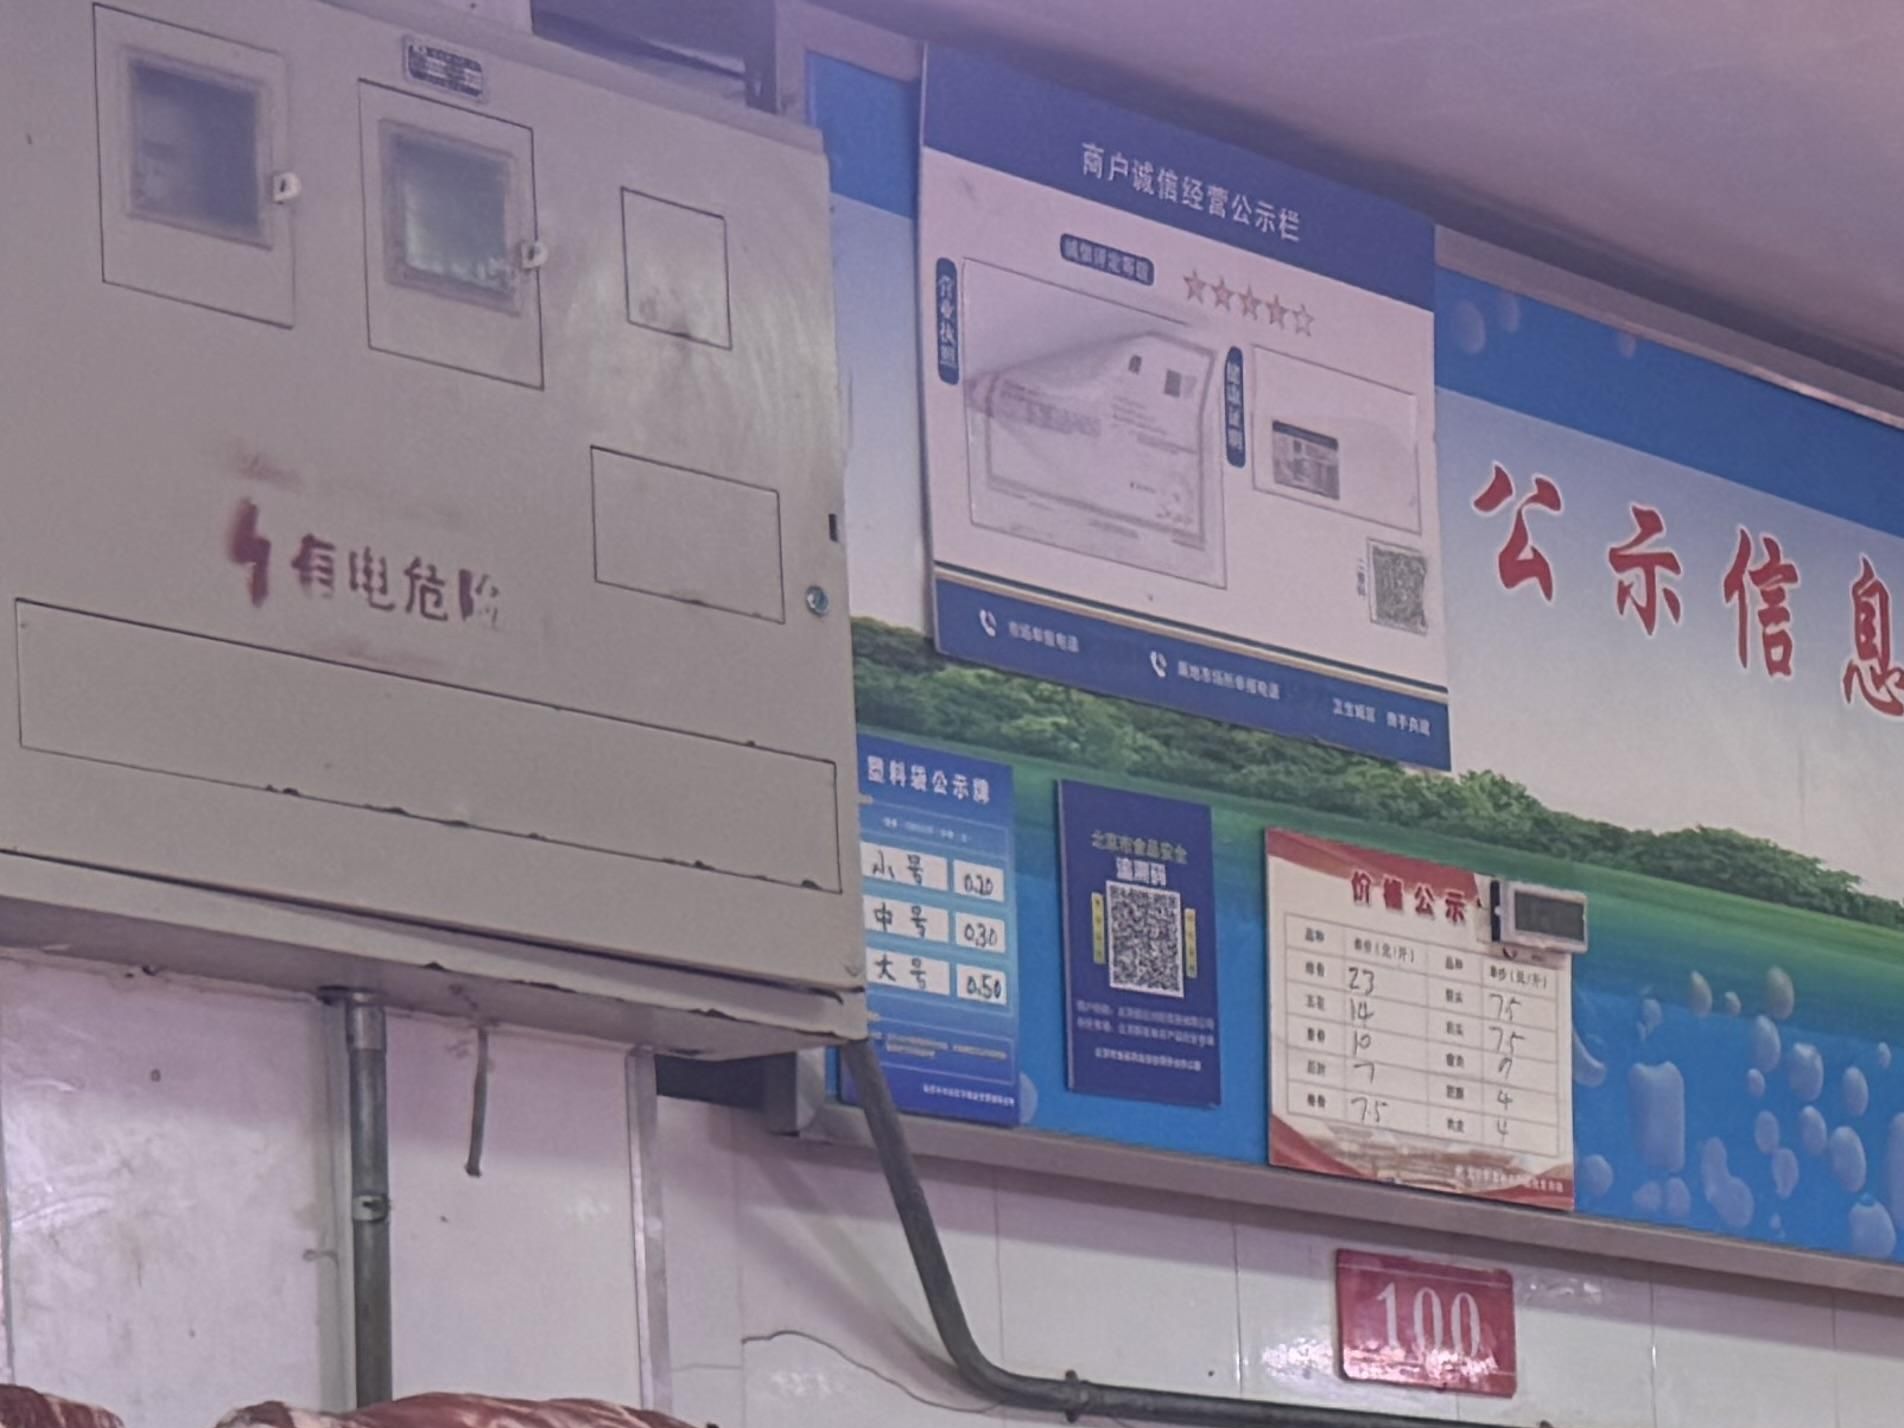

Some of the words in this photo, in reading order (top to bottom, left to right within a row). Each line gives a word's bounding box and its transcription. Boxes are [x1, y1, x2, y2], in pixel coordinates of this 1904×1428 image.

[1081, 141, 1300, 242] 商户诚信经营公示栏
[872, 850, 925, 885] 小号
[1351, 870, 1482, 924] 价格公示
[873, 902, 928, 939] 中号
[873, 955, 928, 990] 大号
[1348, 966, 1376, 996] 23
[1350, 997, 1374, 1022] 14
[1352, 1030, 1372, 1057] 10
[1352, 1061, 1375, 1084] 7
[1497, 1089, 1513, 1111] 4
[1375, 1280, 1482, 1360] 100
